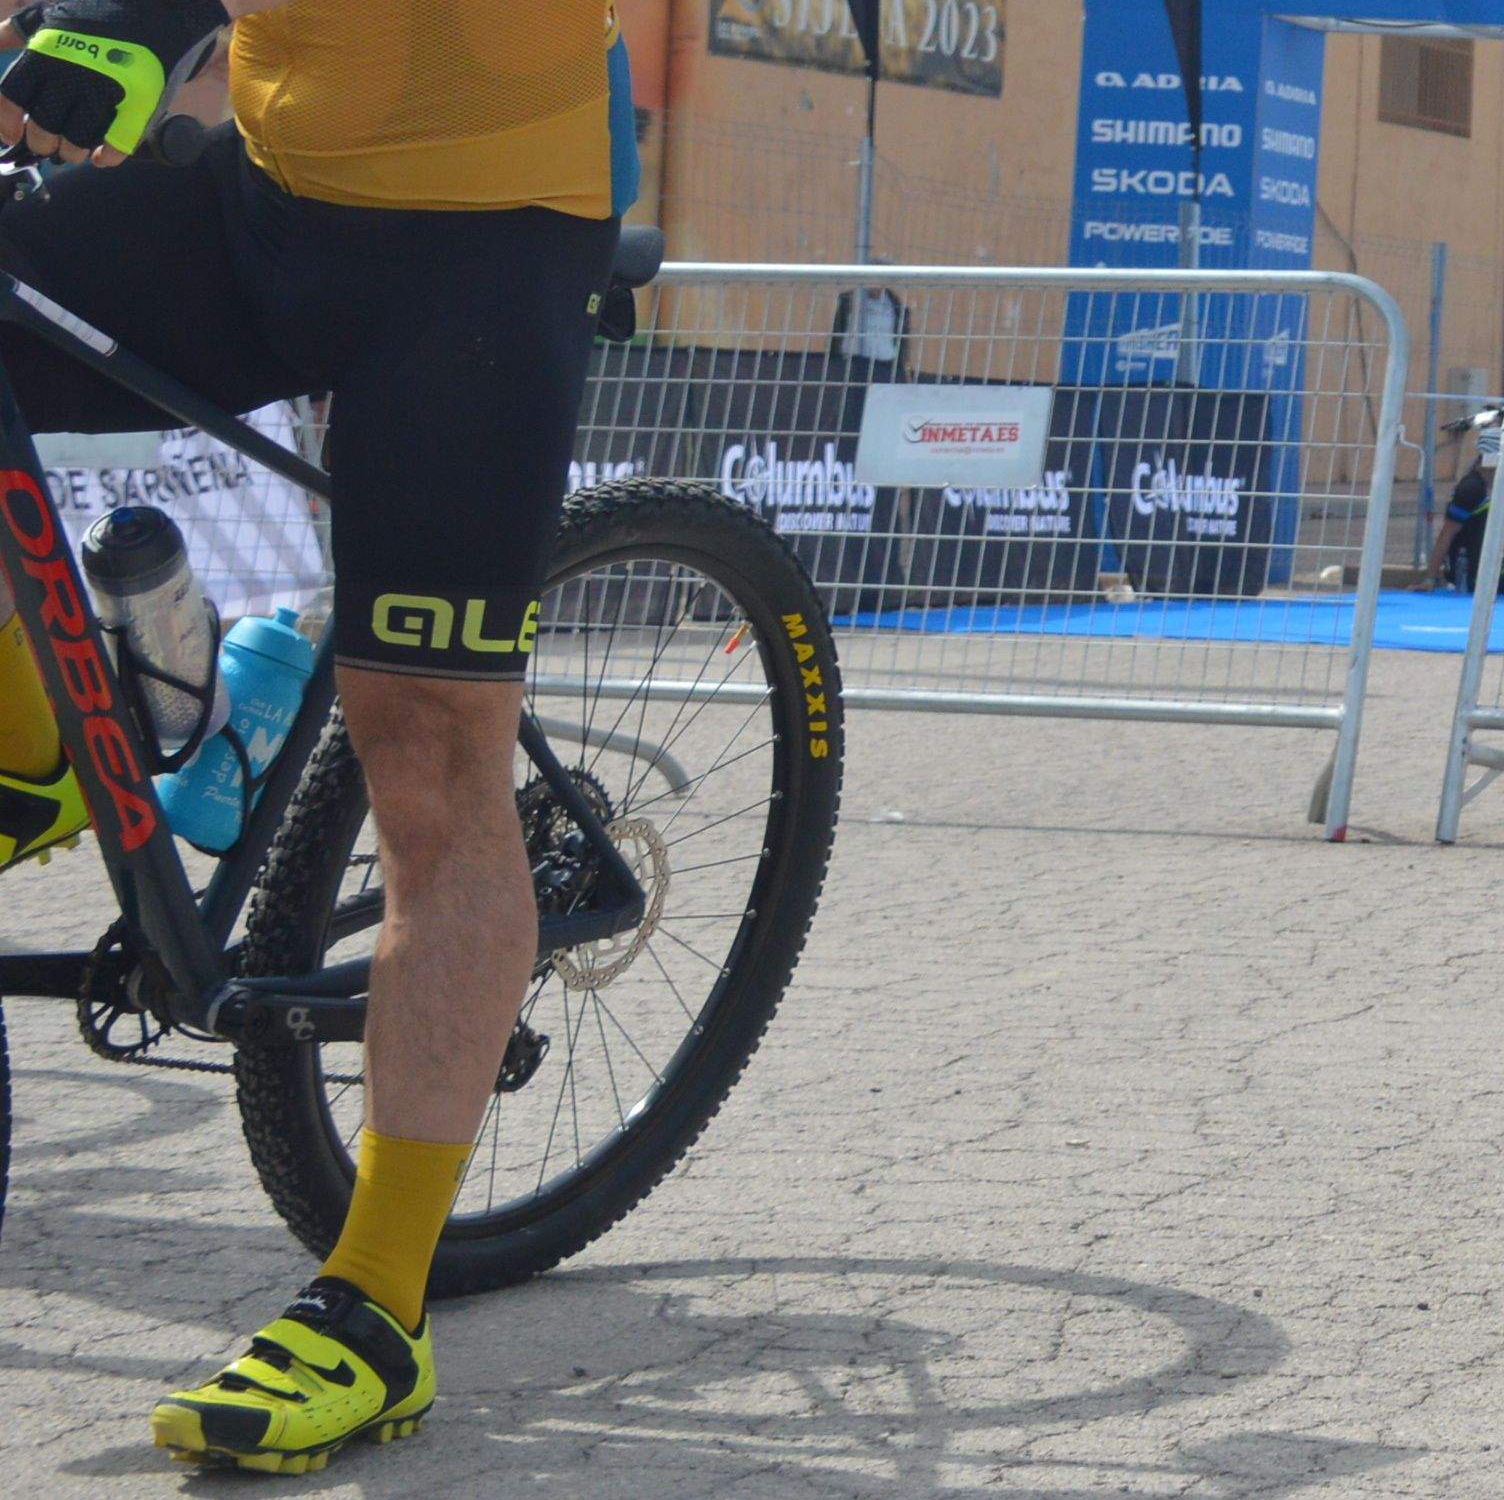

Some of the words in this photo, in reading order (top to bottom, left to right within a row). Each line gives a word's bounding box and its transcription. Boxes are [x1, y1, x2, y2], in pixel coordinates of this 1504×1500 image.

[56, 33, 100, 60] barri
[1132, 73, 1243, 92] ADIA
[1092, 120, 1242, 147] SHIMANO
[1092, 169, 1235, 197] SKODA
[1084, 222, 1233, 245] POWERDE
[1, 468, 157, 851] ORBEA
[782, 612, 830, 760] MAXXIS
